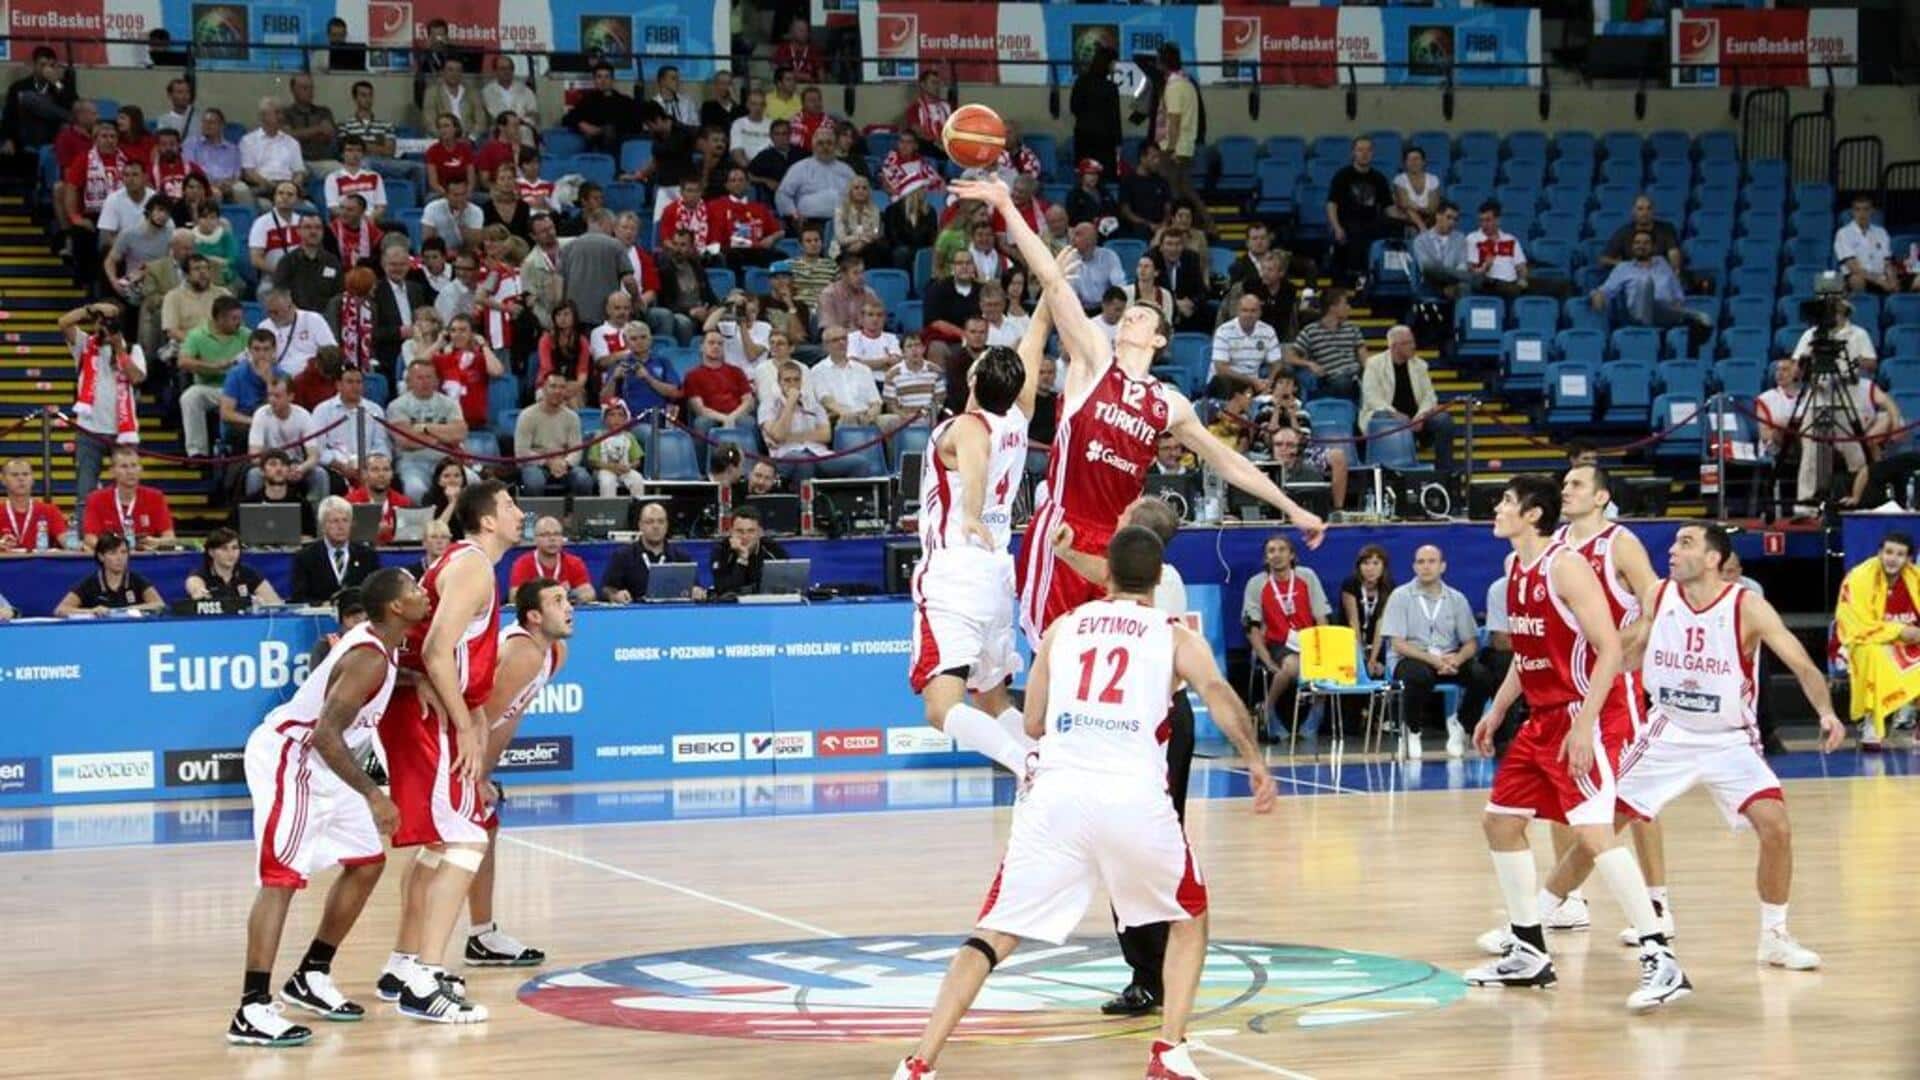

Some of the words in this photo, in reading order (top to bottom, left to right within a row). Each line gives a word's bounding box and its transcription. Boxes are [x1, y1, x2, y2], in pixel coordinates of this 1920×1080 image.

[12, 9, 101, 29] EuroBasket
[106, 13, 145, 30] 2009
[263, 15, 300, 33] FIBA
[501, 24, 537, 42] 2009
[644, 25, 680, 42] FIBA
[920, 33, 995, 49] EuroBasket
[998, 35, 1031, 50] 2009
[1466, 33, 1497, 51] FIBA
[1263, 35, 1334, 51] EuroBasket
[1338, 36, 1370, 51] 2009
[1726, 37, 1804, 54] EuroBasket
[1810, 38, 1843, 54] 2009
[1121, 379, 1147, 411] 12
[995, 468, 1010, 505] 4
[1077, 616, 1149, 638] EVTIMOV
[1684, 627, 1706, 653] 15
[725, 644, 776, 659] WARSAW
[149, 641, 312, 693] EuroBa
[1654, 649, 1732, 676] BULGARIA
[15, 665, 81, 682] KATOWICE
[1076, 646, 1130, 705] 12
[1074, 714, 1141, 733] EUROINS
[678, 741, 735, 755] BEKO
[774, 745, 804, 755] SPORT
[775, 736, 805, 746] INTER
[844, 737, 879, 748] ORLEN
[0, 763, 24, 779] en
[77, 761, 151, 780] MONDO
[178, 758, 220, 782] ovi
